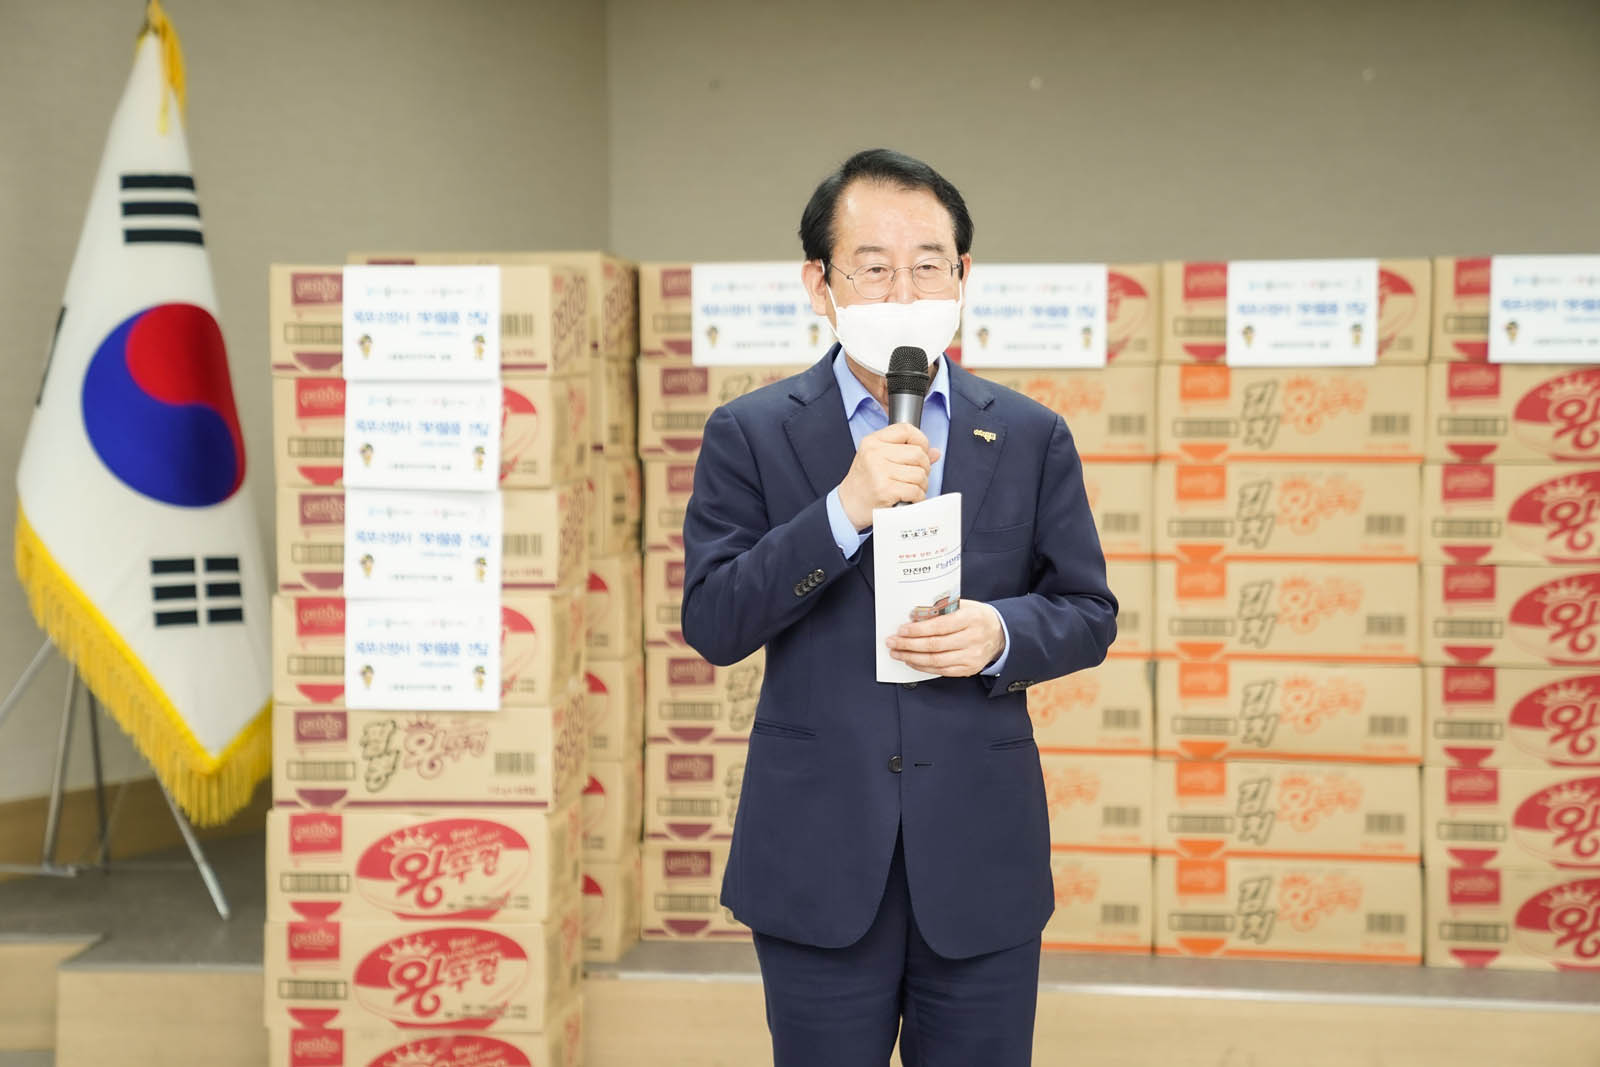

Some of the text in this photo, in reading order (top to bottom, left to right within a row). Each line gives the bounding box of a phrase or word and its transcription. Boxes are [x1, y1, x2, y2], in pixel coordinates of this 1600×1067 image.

[902, 566, 931, 577] 안전한
[391, 844, 504, 909] 왕뚜껑
[388, 953, 501, 1017] 왕뚜껑
